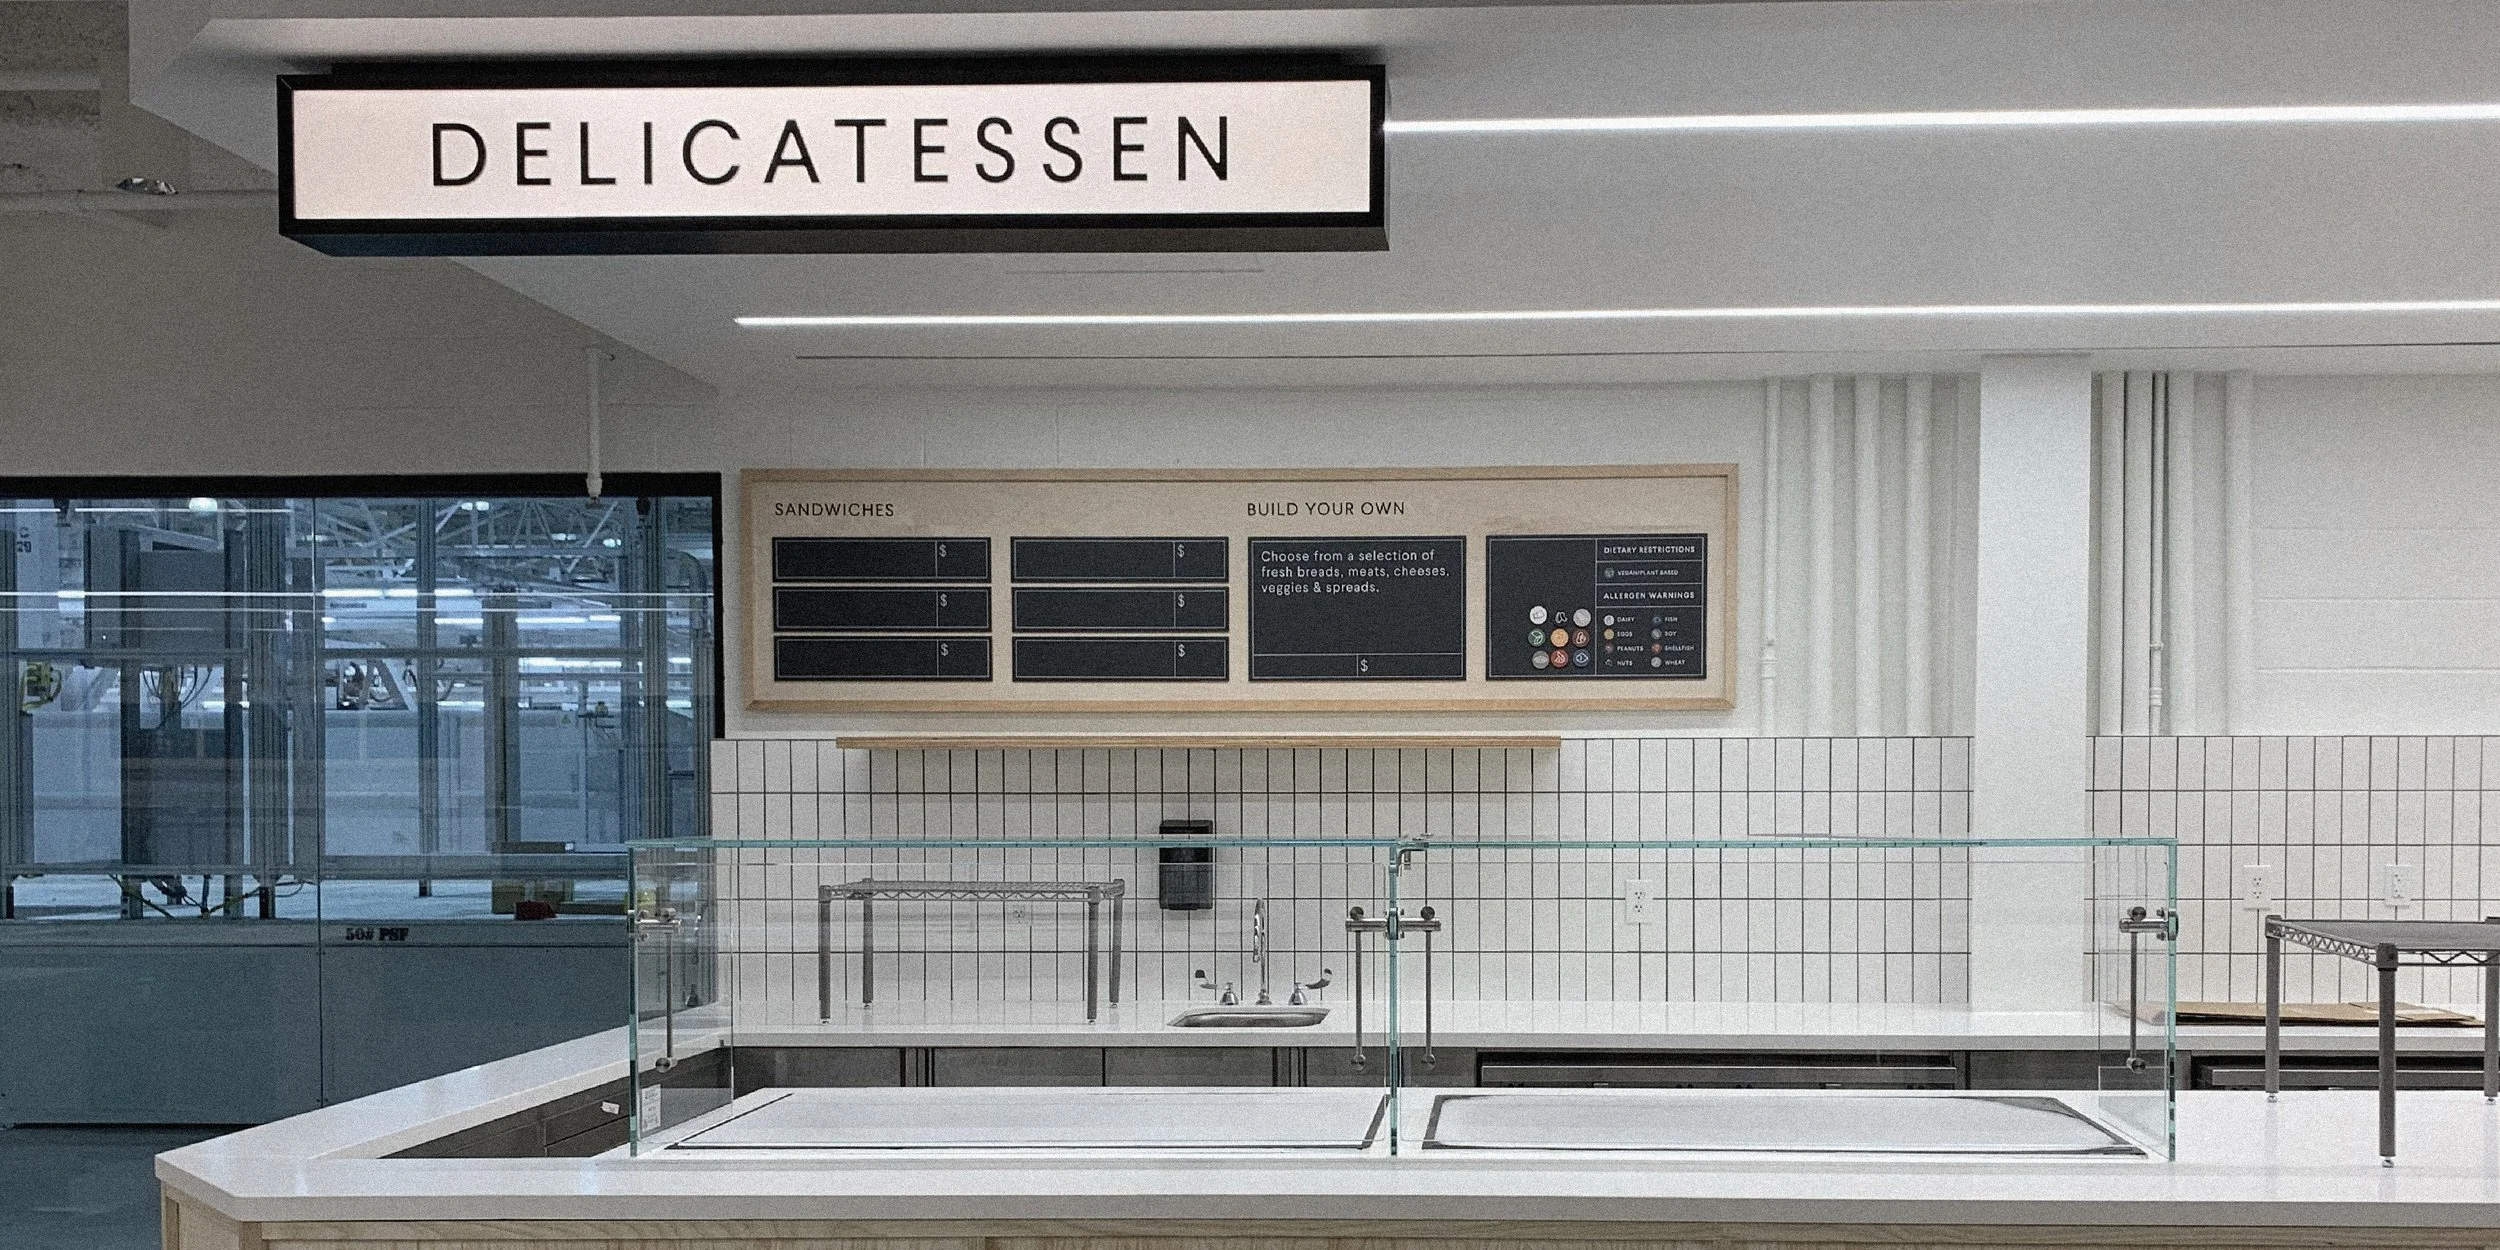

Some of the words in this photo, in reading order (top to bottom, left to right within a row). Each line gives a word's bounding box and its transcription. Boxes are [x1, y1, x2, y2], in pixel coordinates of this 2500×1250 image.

[431, 116, 1229, 187] DELICATESSEN
[775, 502, 894, 517] SANDWICHES
[1247, 503, 1299, 516] BUILD
[1305, 502, 1354, 516] YOUR
[1361, 501, 1405, 516] OWN
[1261, 550, 1310, 562] Choose
[1314, 550, 1343, 562] from
[1347, 553, 1354, 561] a
[1359, 550, 1417, 562] selection
[1421, 549, 1435, 561] of
[1603, 546, 1637, 554] DIETARY
[1639, 545, 1695, 553] RESTRICTIONS
[1261, 566, 1293, 578] fresh
[1297, 565, 1344, 579] breads,
[1348, 566, 1390, 579] meats,
[1261, 582, 1309, 596] veggies
[1313, 582, 1321, 593] &
[1326, 580, 1380, 594] spreads.
[1648, 591, 1695, 599] WARNINGS
